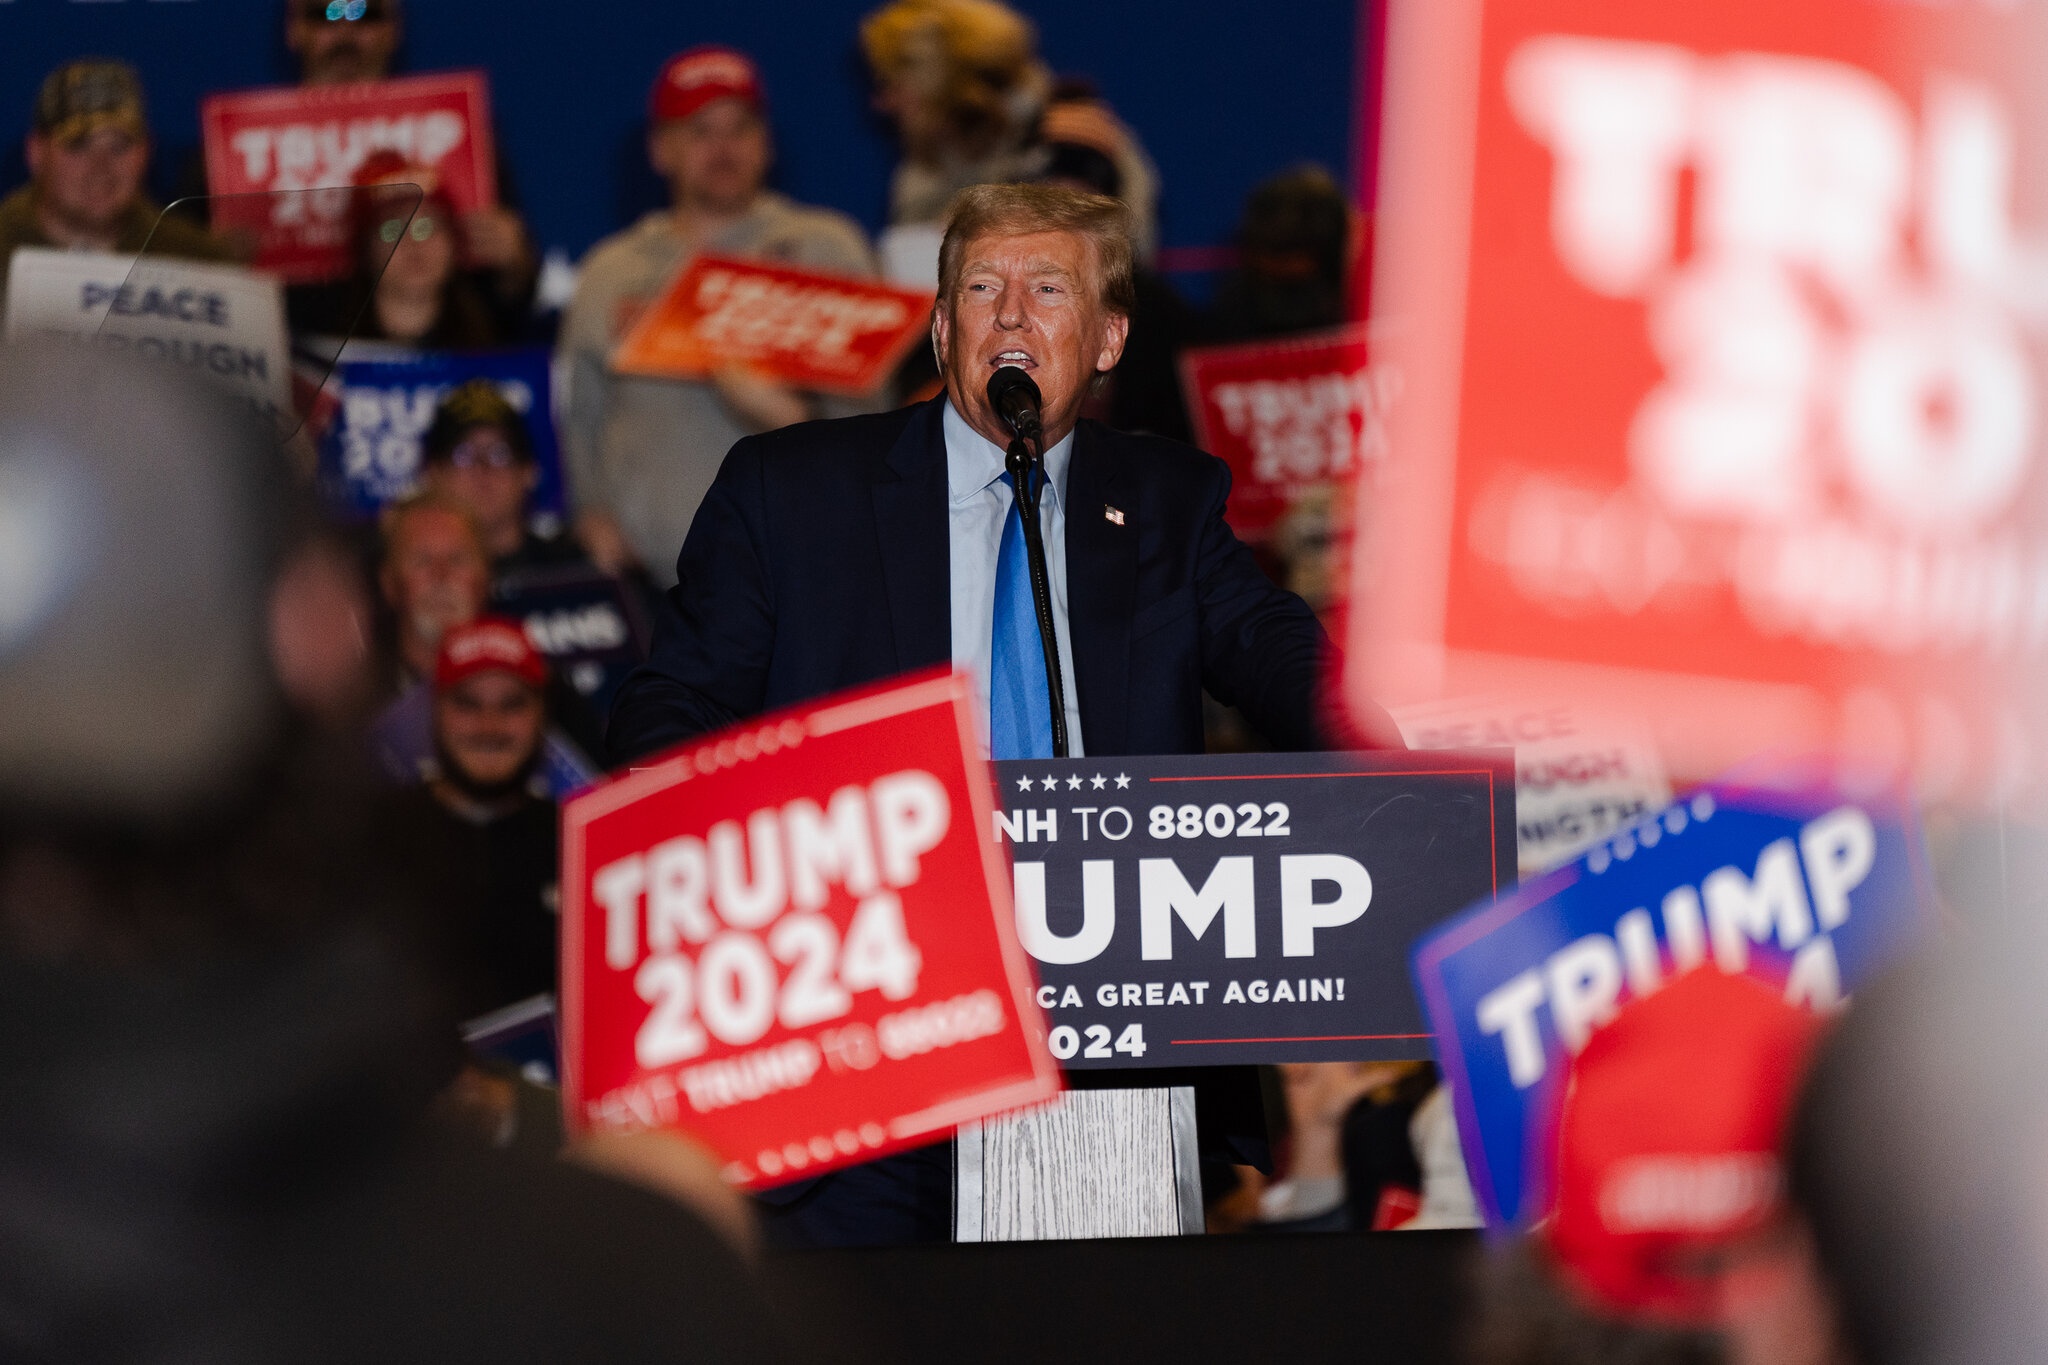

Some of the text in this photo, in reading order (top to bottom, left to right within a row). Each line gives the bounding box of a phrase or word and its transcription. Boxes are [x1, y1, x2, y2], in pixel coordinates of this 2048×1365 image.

[232, 111, 464, 184] TRUMP
[81, 281, 230, 327] PEACE
[992, 802, 1291, 843] NH TO 88022
[1518, 796, 1648, 843] NGTH
[593, 769, 951, 970] TRUMP
[1014, 853, 1373, 965] UMP
[1475, 807, 1877, 1088] TRUMP
[634, 893, 923, 1069] 2024
[1097, 980, 1210, 1008] GREAT
[1222, 977, 1345, 1005] AGAIN!
[1048, 1023, 1147, 1060] 024
